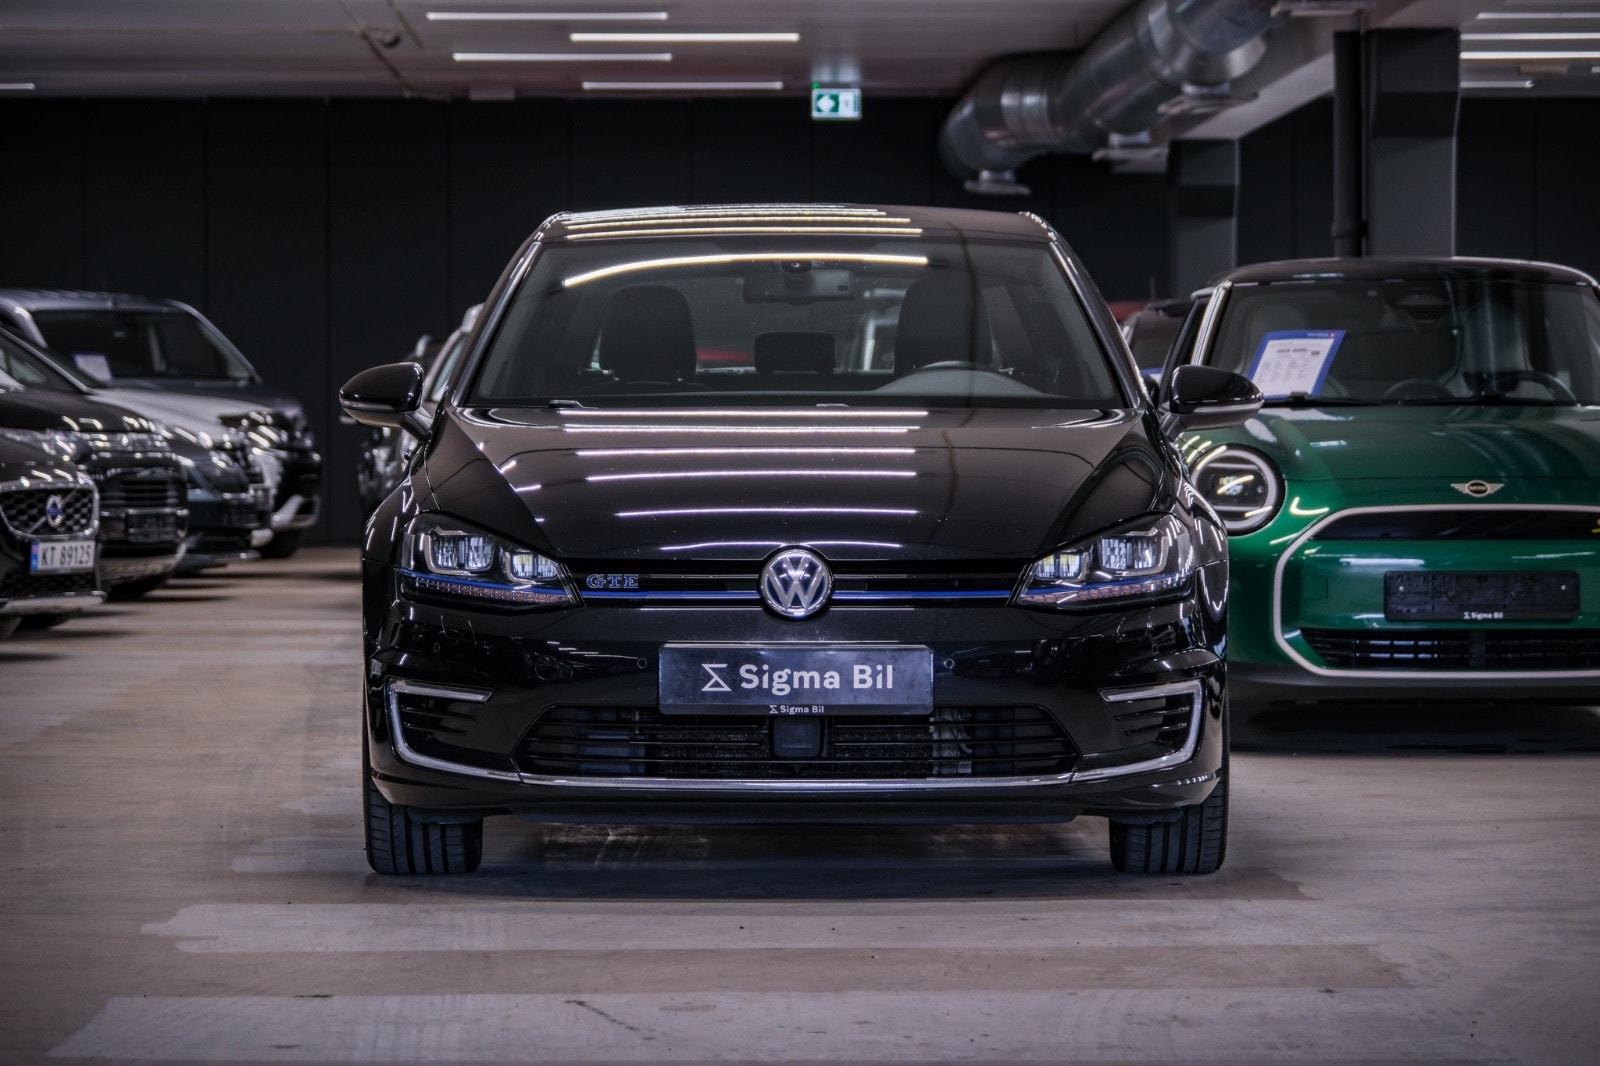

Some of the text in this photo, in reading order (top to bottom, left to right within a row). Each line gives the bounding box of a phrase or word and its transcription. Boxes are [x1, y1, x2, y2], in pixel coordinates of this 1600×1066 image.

[41, 545, 91, 566] KT 89125
[586, 573, 639, 589] GTE
[1471, 611, 1492, 620] Sigma
[739, 664, 894, 696] Sigma Bil
[780, 704, 825, 715] Sigma Bil
